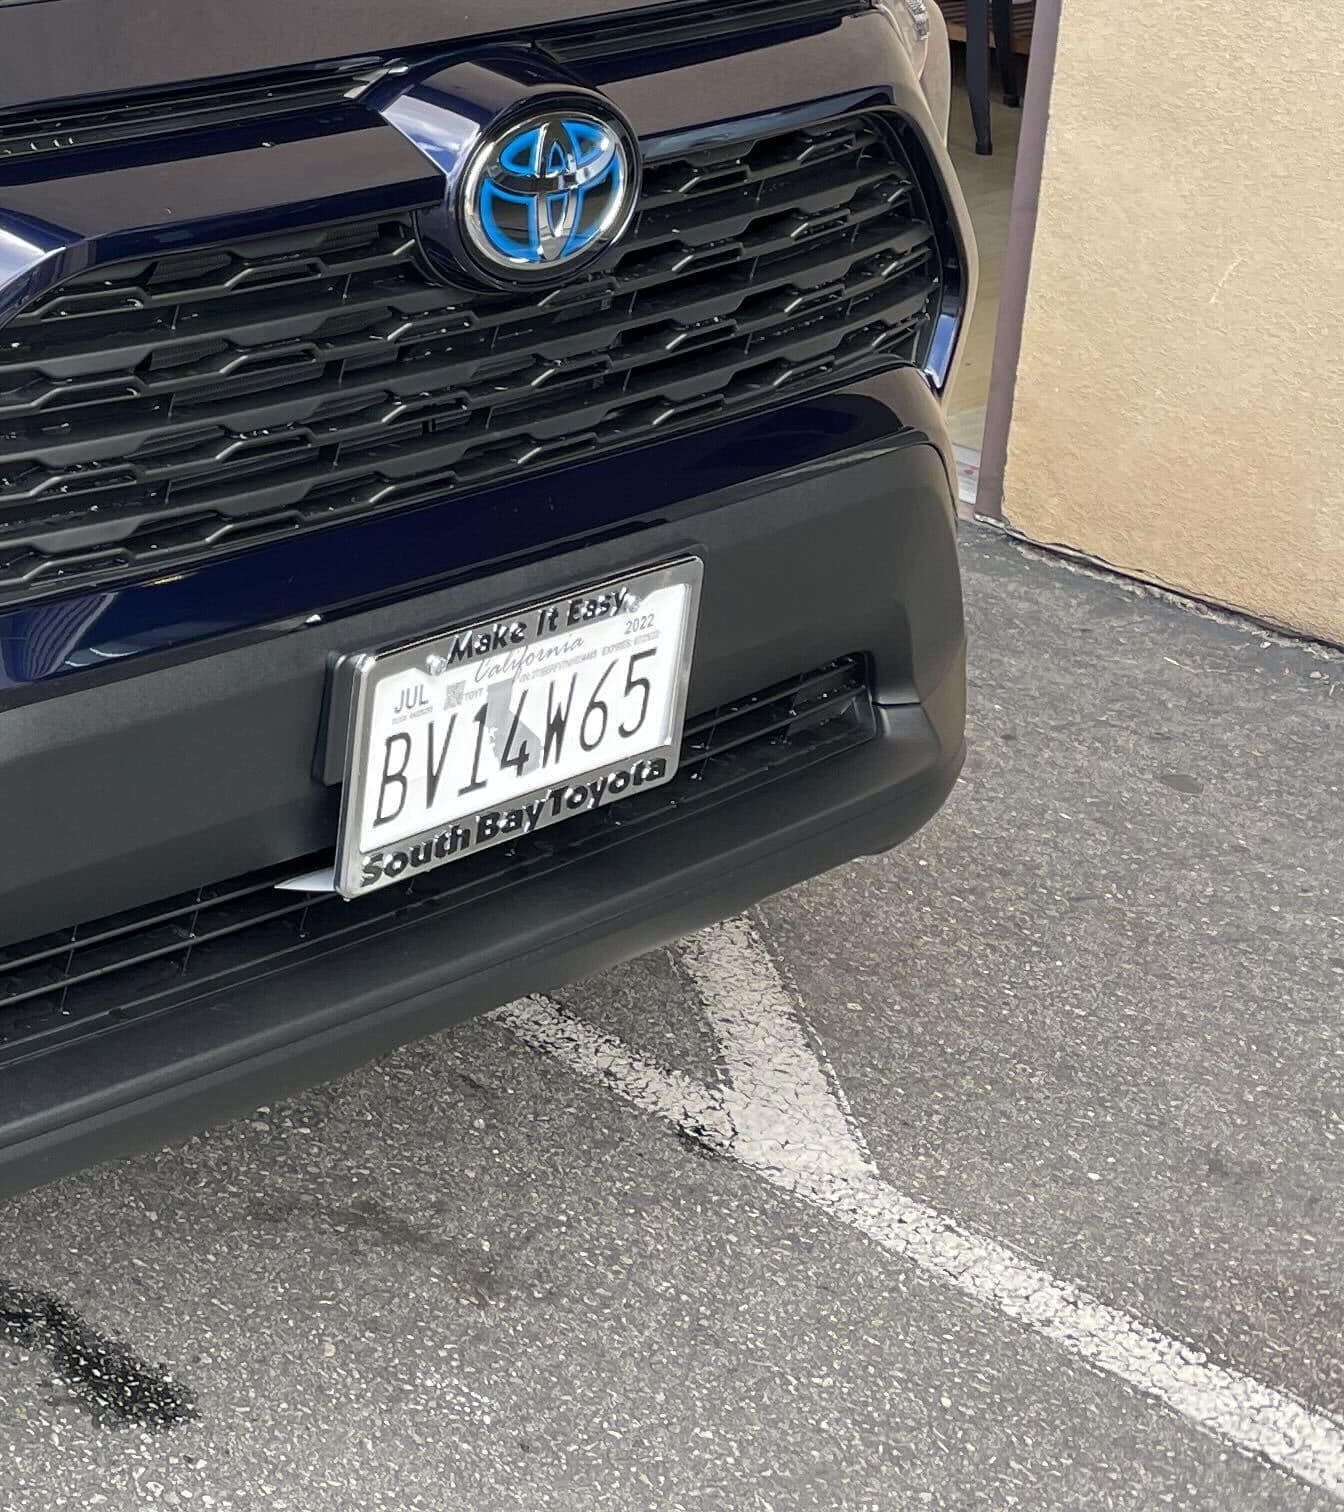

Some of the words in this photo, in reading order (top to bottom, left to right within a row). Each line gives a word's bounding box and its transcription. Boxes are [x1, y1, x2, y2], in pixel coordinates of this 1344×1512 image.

[447, 620, 528, 666] Make
[536, 606, 559, 637] It
[567, 587, 630, 626] Easy
[624, 614, 656, 636] 2022
[474, 636, 585, 684] California
[394, 684, 430, 714] JUL
[373, 646, 659, 828] BV14W65
[360, 824, 471, 888] South
[474, 796, 546, 846] Bay
[547, 757, 668, 816] Toyota
